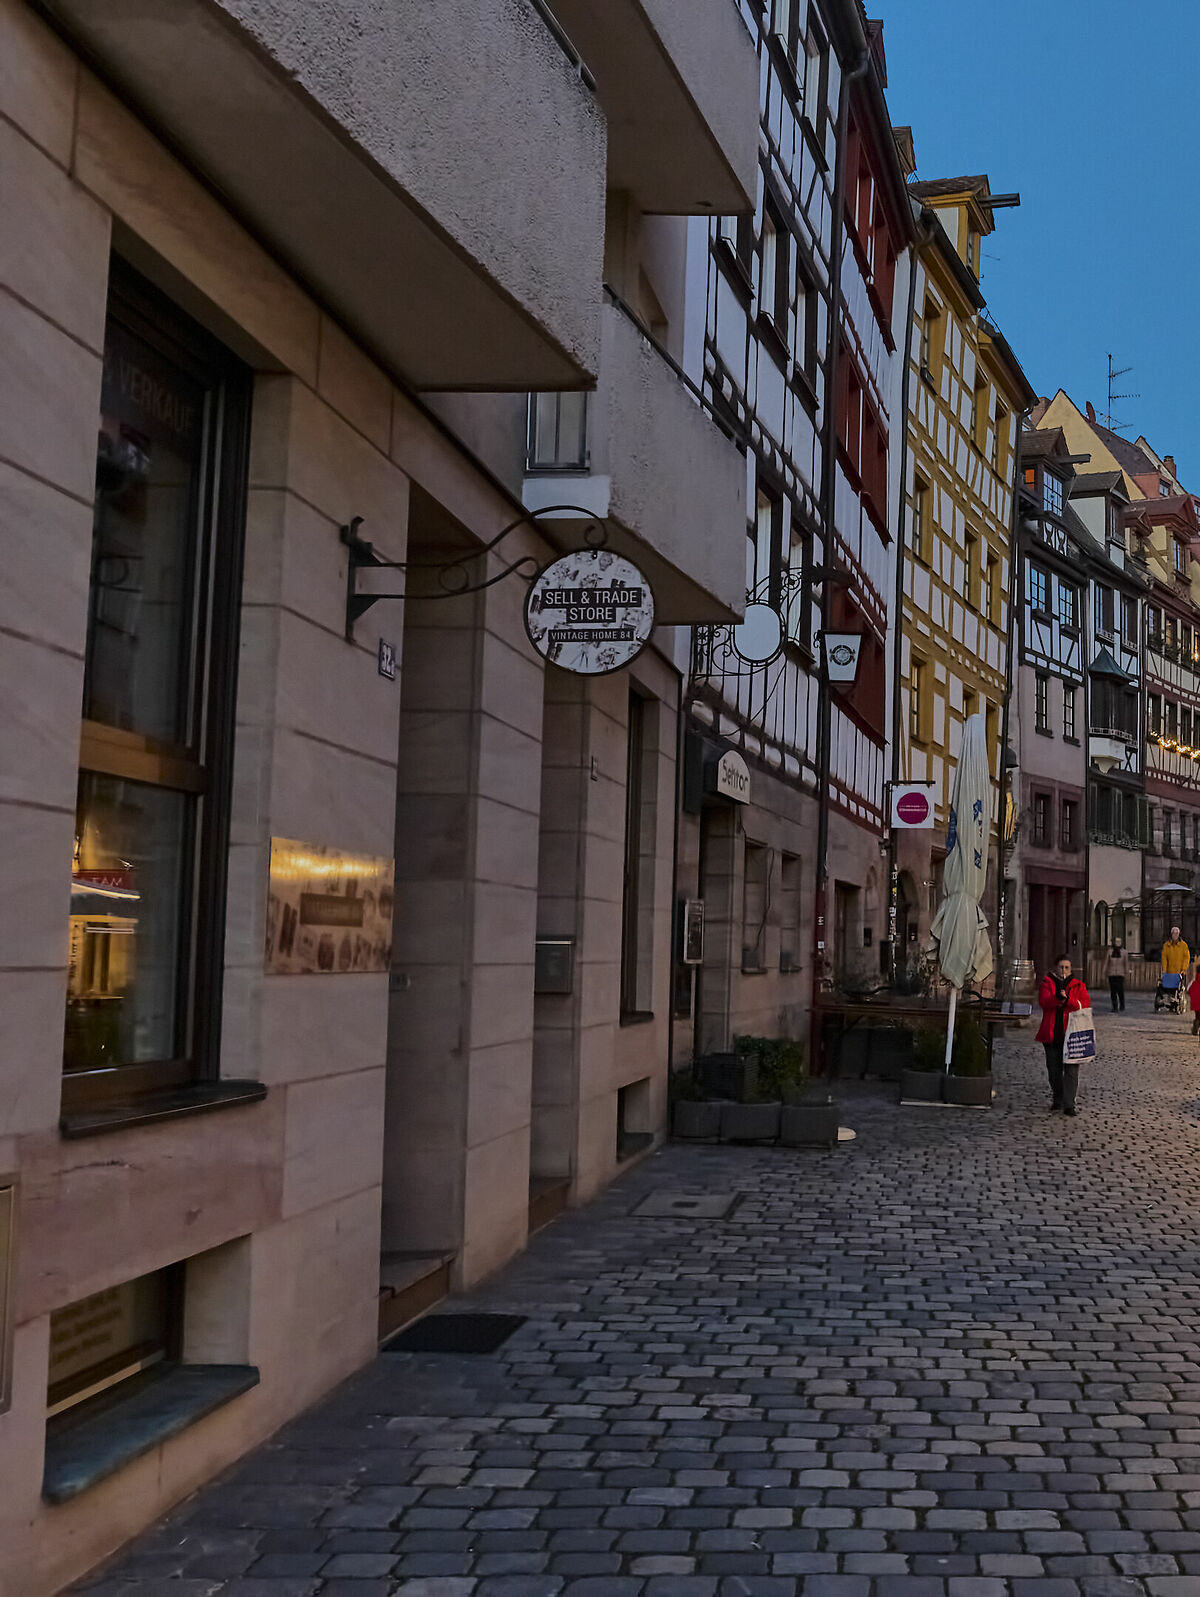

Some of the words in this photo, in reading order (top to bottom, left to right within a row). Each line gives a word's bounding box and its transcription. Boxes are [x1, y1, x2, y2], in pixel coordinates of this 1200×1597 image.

[545, 590, 578, 605] SELL
[581, 591, 591, 605] &
[594, 590, 639, 604] TRADE
[569, 606, 614, 621] STORE
[551, 631, 590, 641] VINTAGE
[592, 630, 619, 640] HOME
[620, 630, 632, 640] 84
